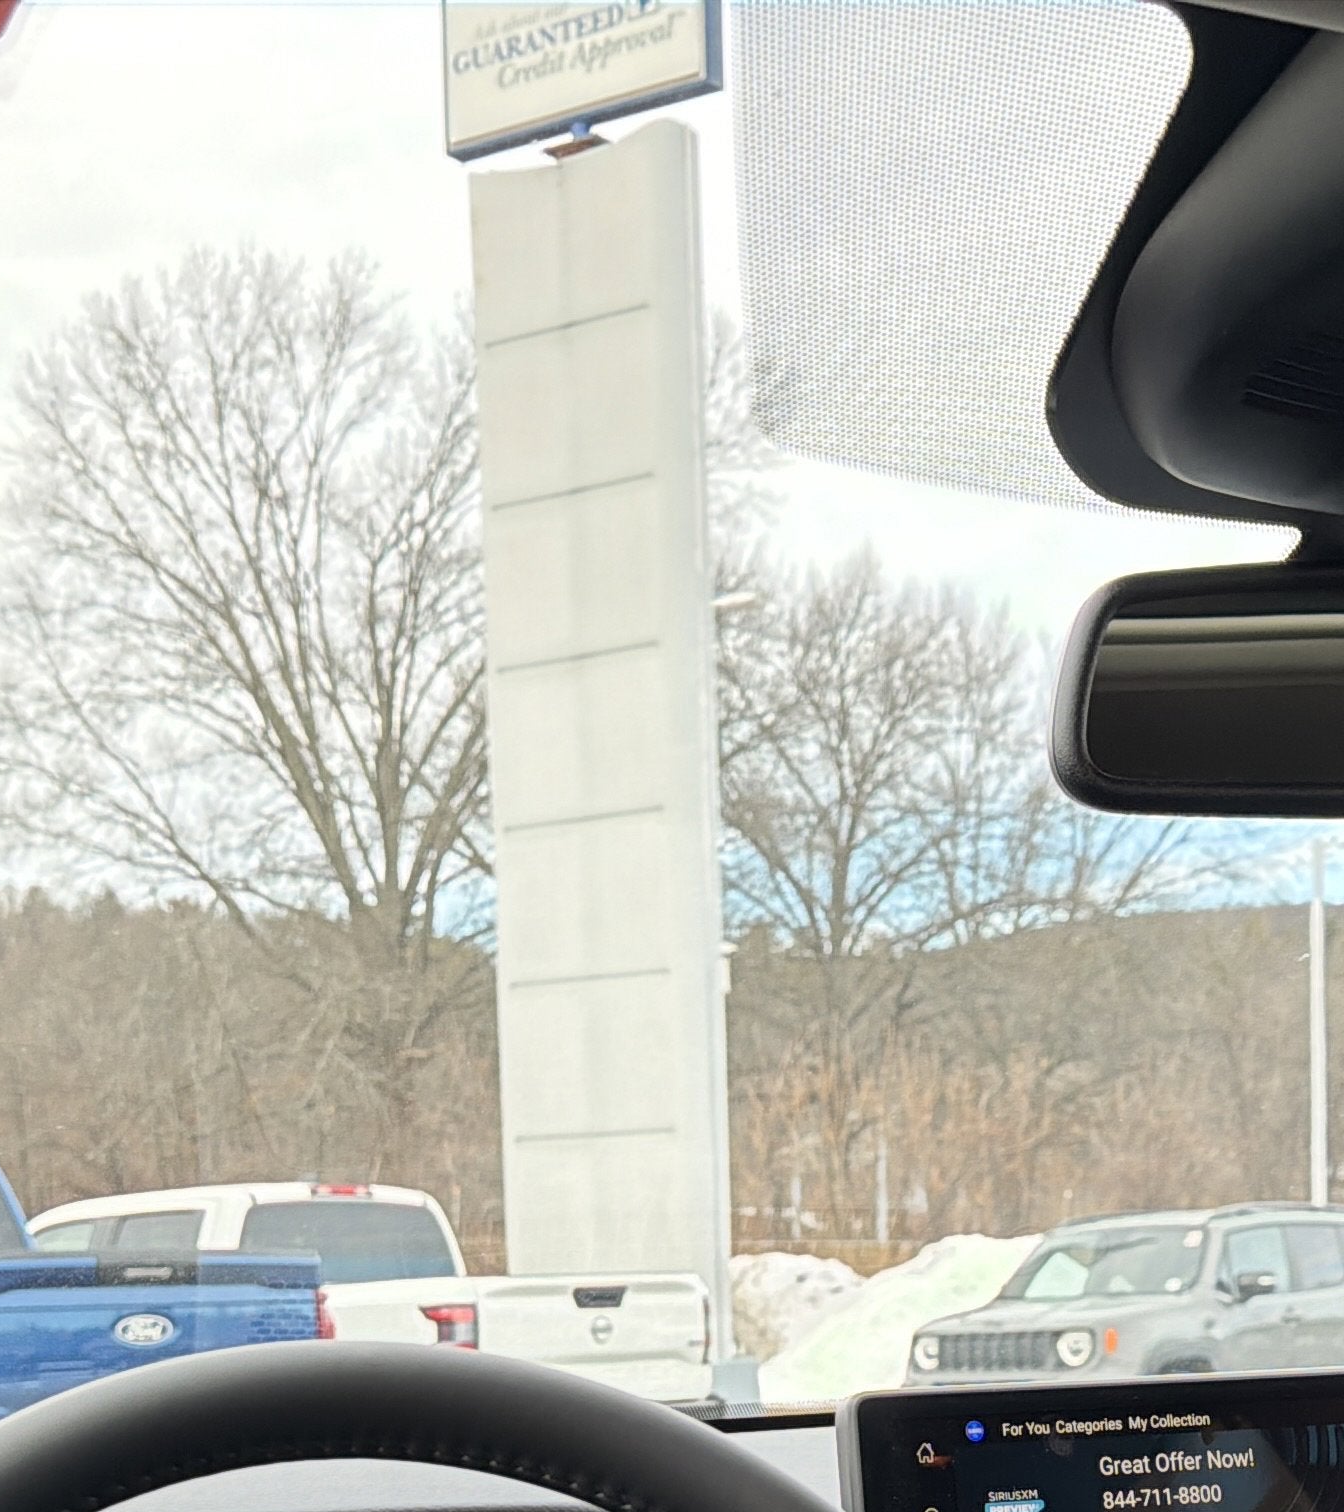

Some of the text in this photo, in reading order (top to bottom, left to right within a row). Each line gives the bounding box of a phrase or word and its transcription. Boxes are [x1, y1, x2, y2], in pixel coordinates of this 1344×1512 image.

[452, 3, 624, 75] GUARANTEED
[1002, 1413, 1211, 1437] For You Categories My Collection
[1099, 1447, 1256, 1477] Great Offer Now!
[988, 1489, 1040, 1502] SIRIUSXM
[1102, 1484, 1223, 1511] 844-711-8800
